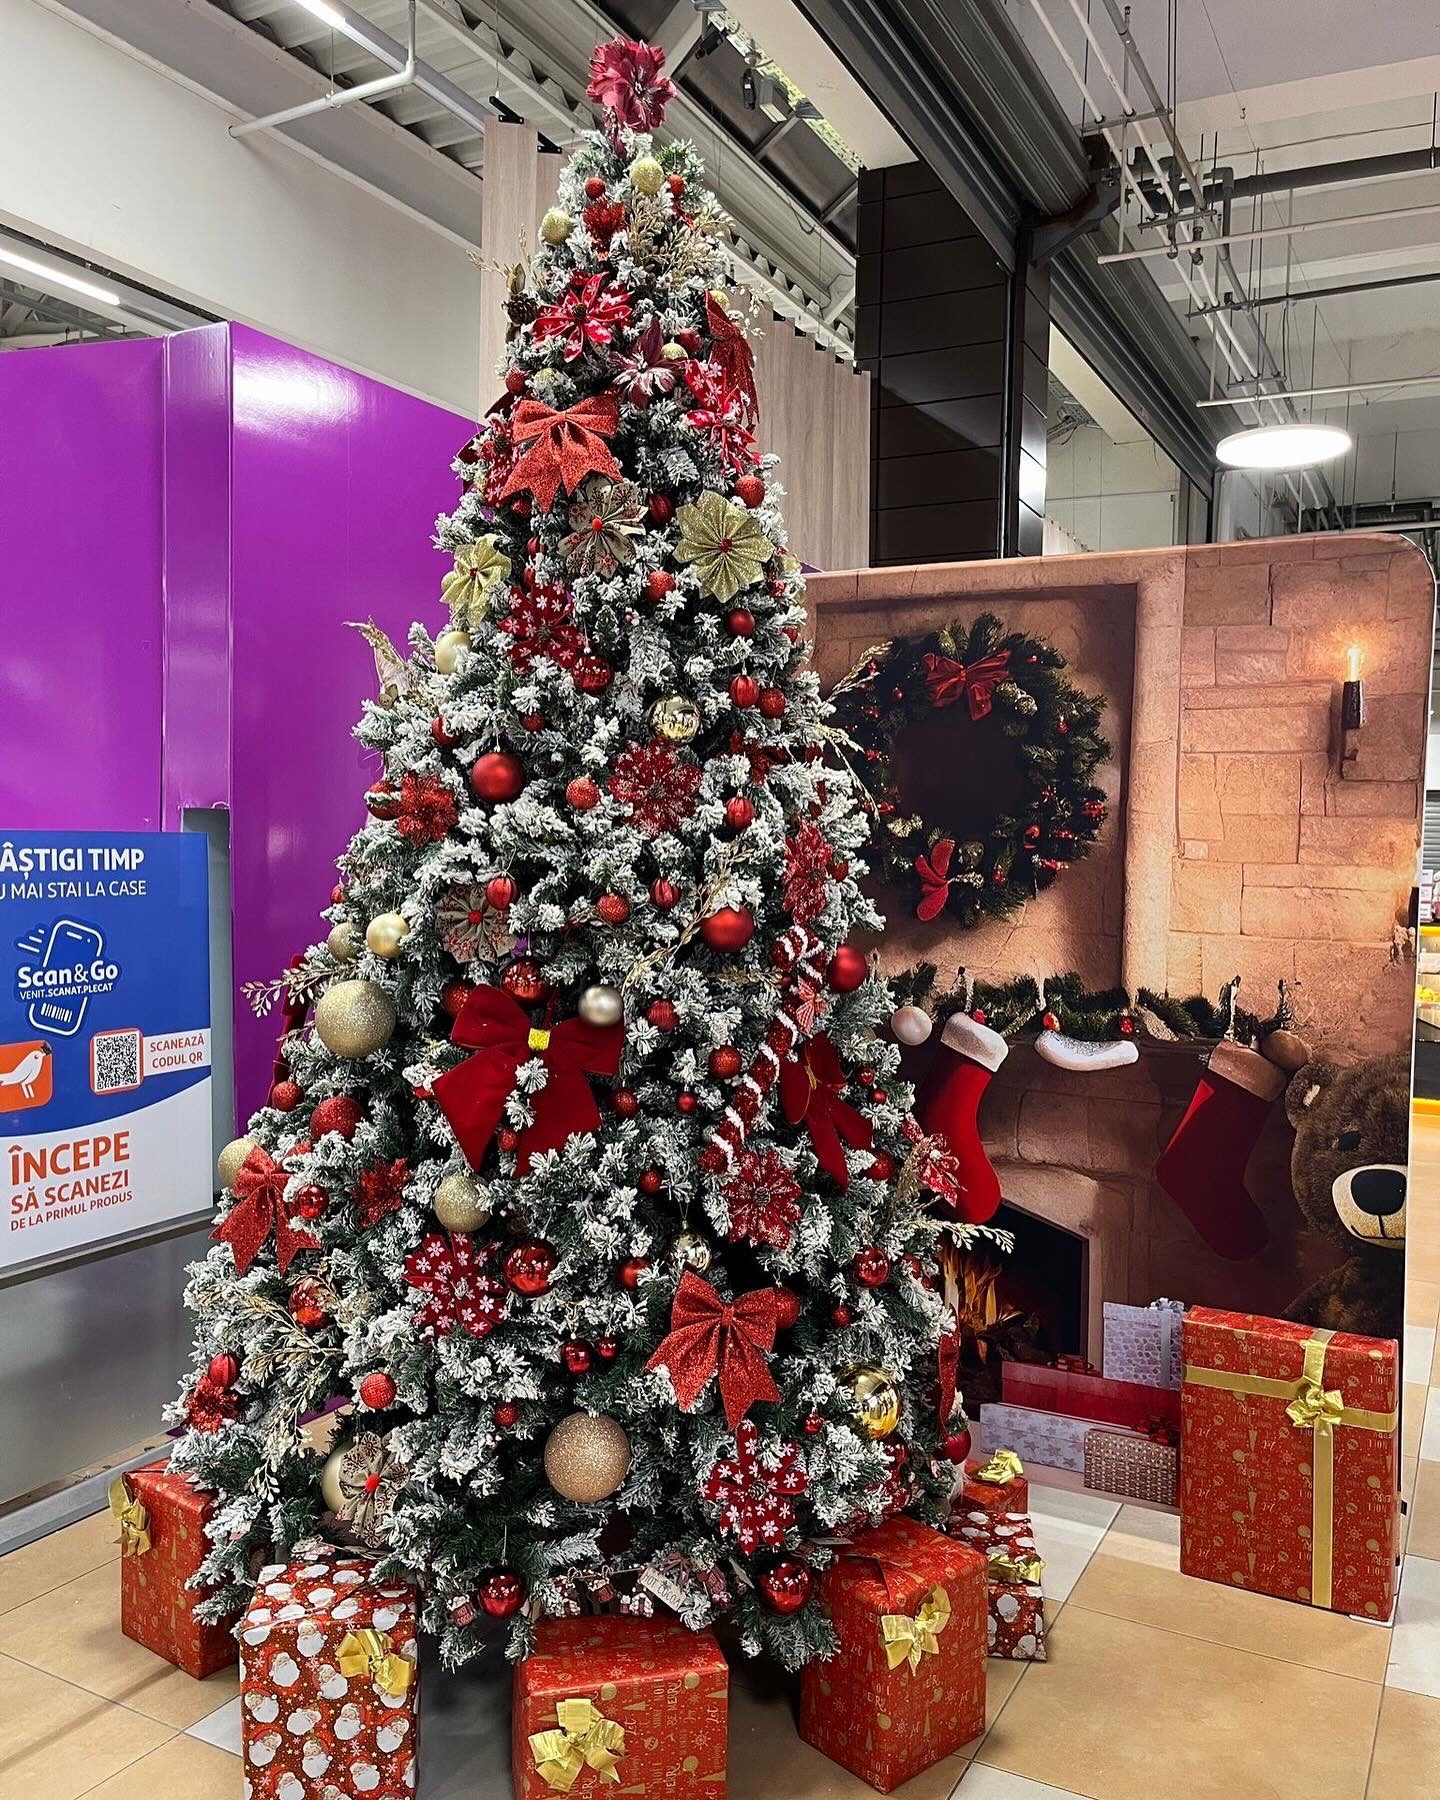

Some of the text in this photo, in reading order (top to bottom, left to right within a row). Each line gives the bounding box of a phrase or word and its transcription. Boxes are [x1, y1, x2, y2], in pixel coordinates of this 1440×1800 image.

[88, 848, 145, 871] TIMP
[11, 882, 43, 899] MAI
[47, 881, 82, 898] STAI
[86, 881, 106, 897] LA
[109, 880, 147, 896] CASE
[18, 960, 118, 988] Scan&Go
[152, 1052, 203, 1069] CODUL QR
[8, 1131, 130, 1186] ÎNCEPE
[11, 1169, 129, 1215] SĂ SCANEZI
[10, 1191, 133, 1231] DE LA PRIMUL PRODUS
